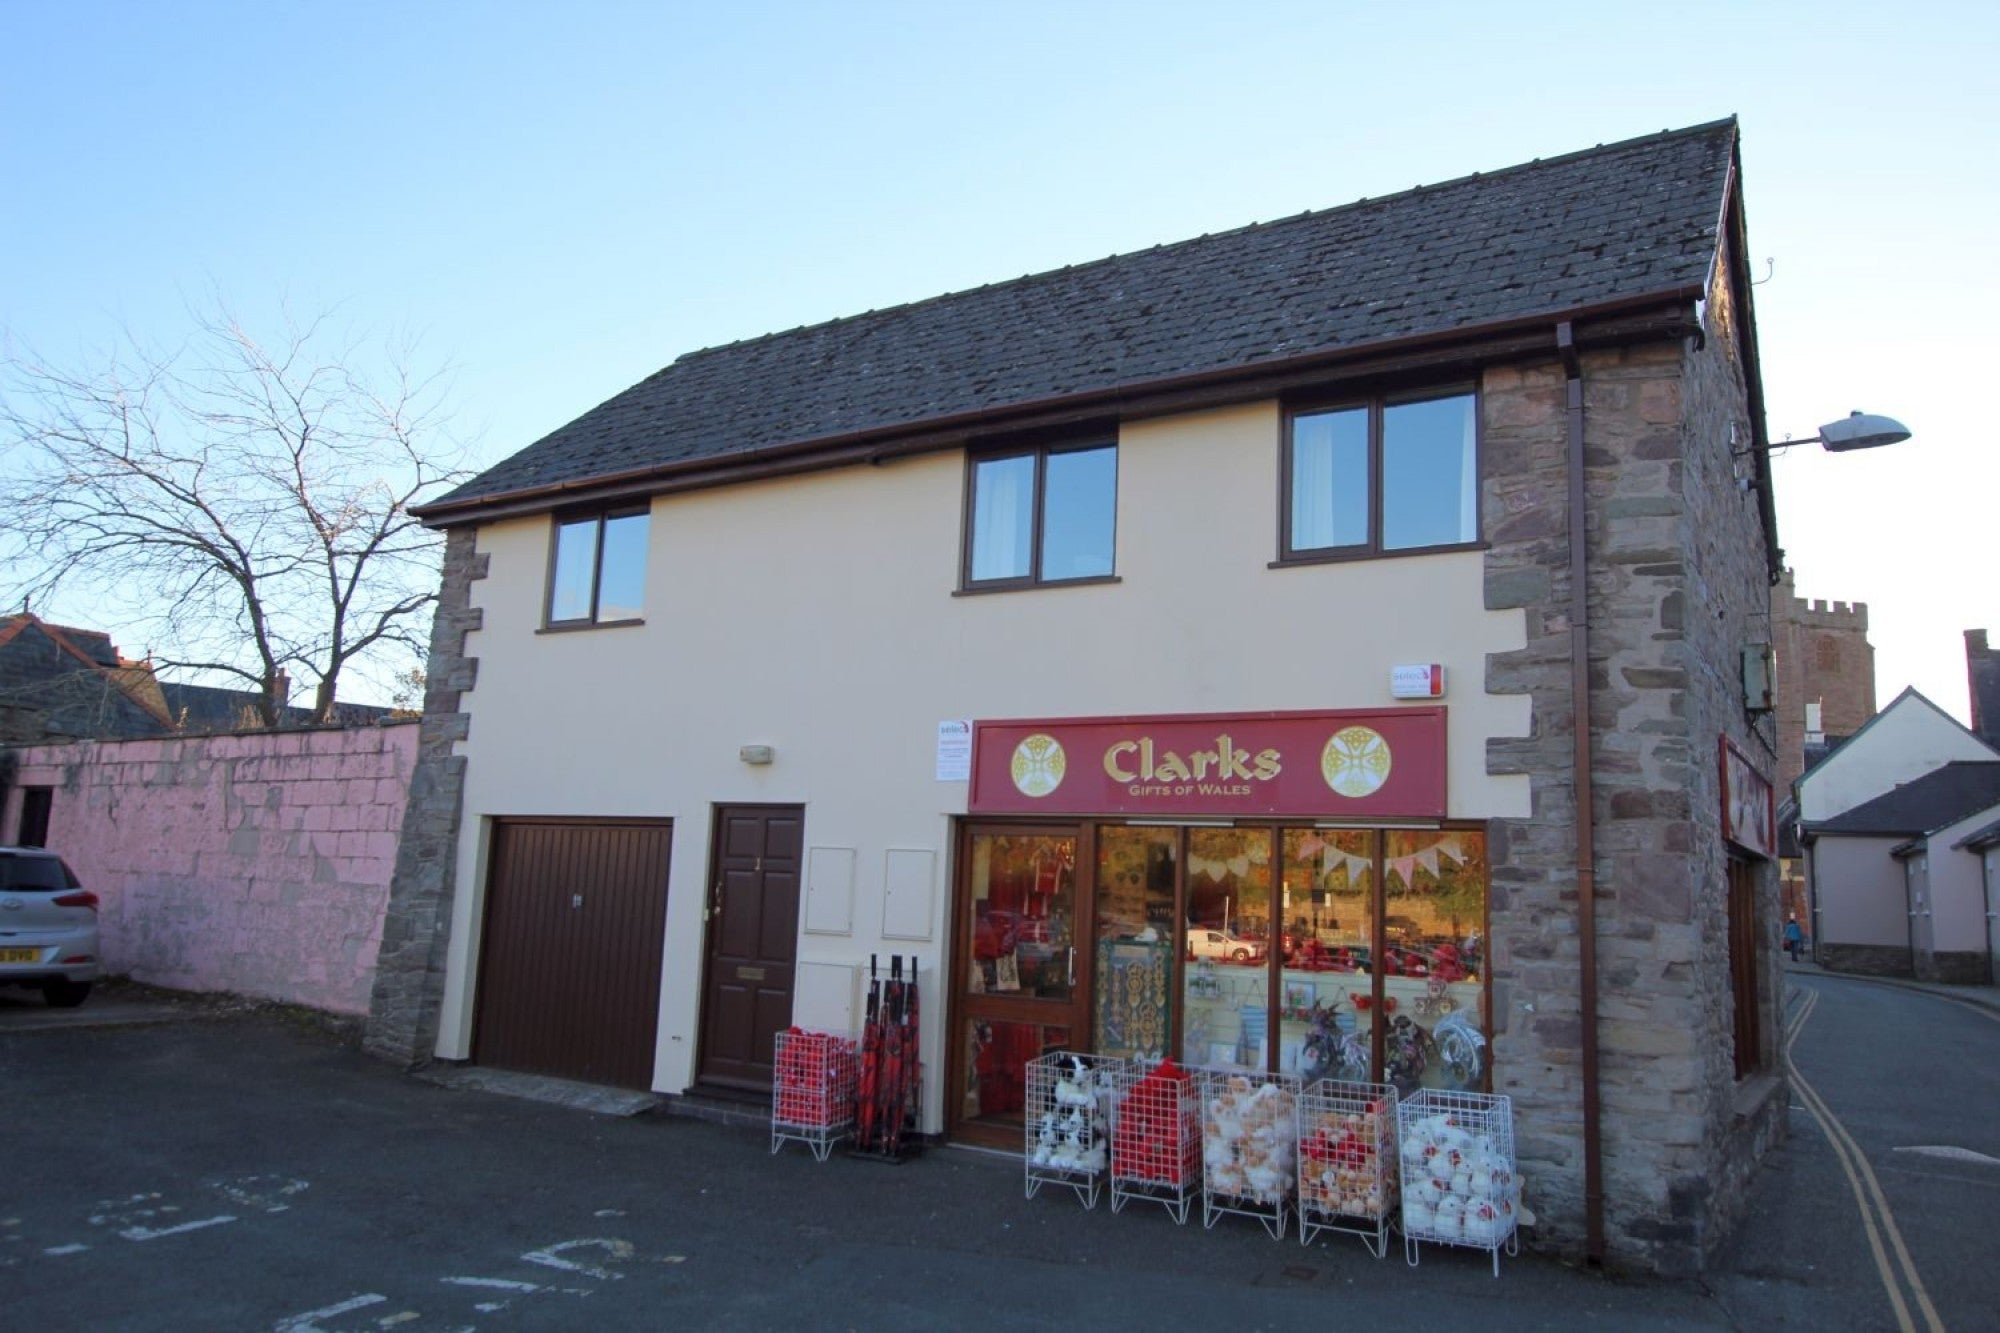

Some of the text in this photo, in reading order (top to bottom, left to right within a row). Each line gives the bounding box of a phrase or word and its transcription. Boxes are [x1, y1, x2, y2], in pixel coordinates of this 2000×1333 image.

[1103, 734, 1282, 783] Clarks
[1129, 783, 1251, 797] GIFTS OF WALES
